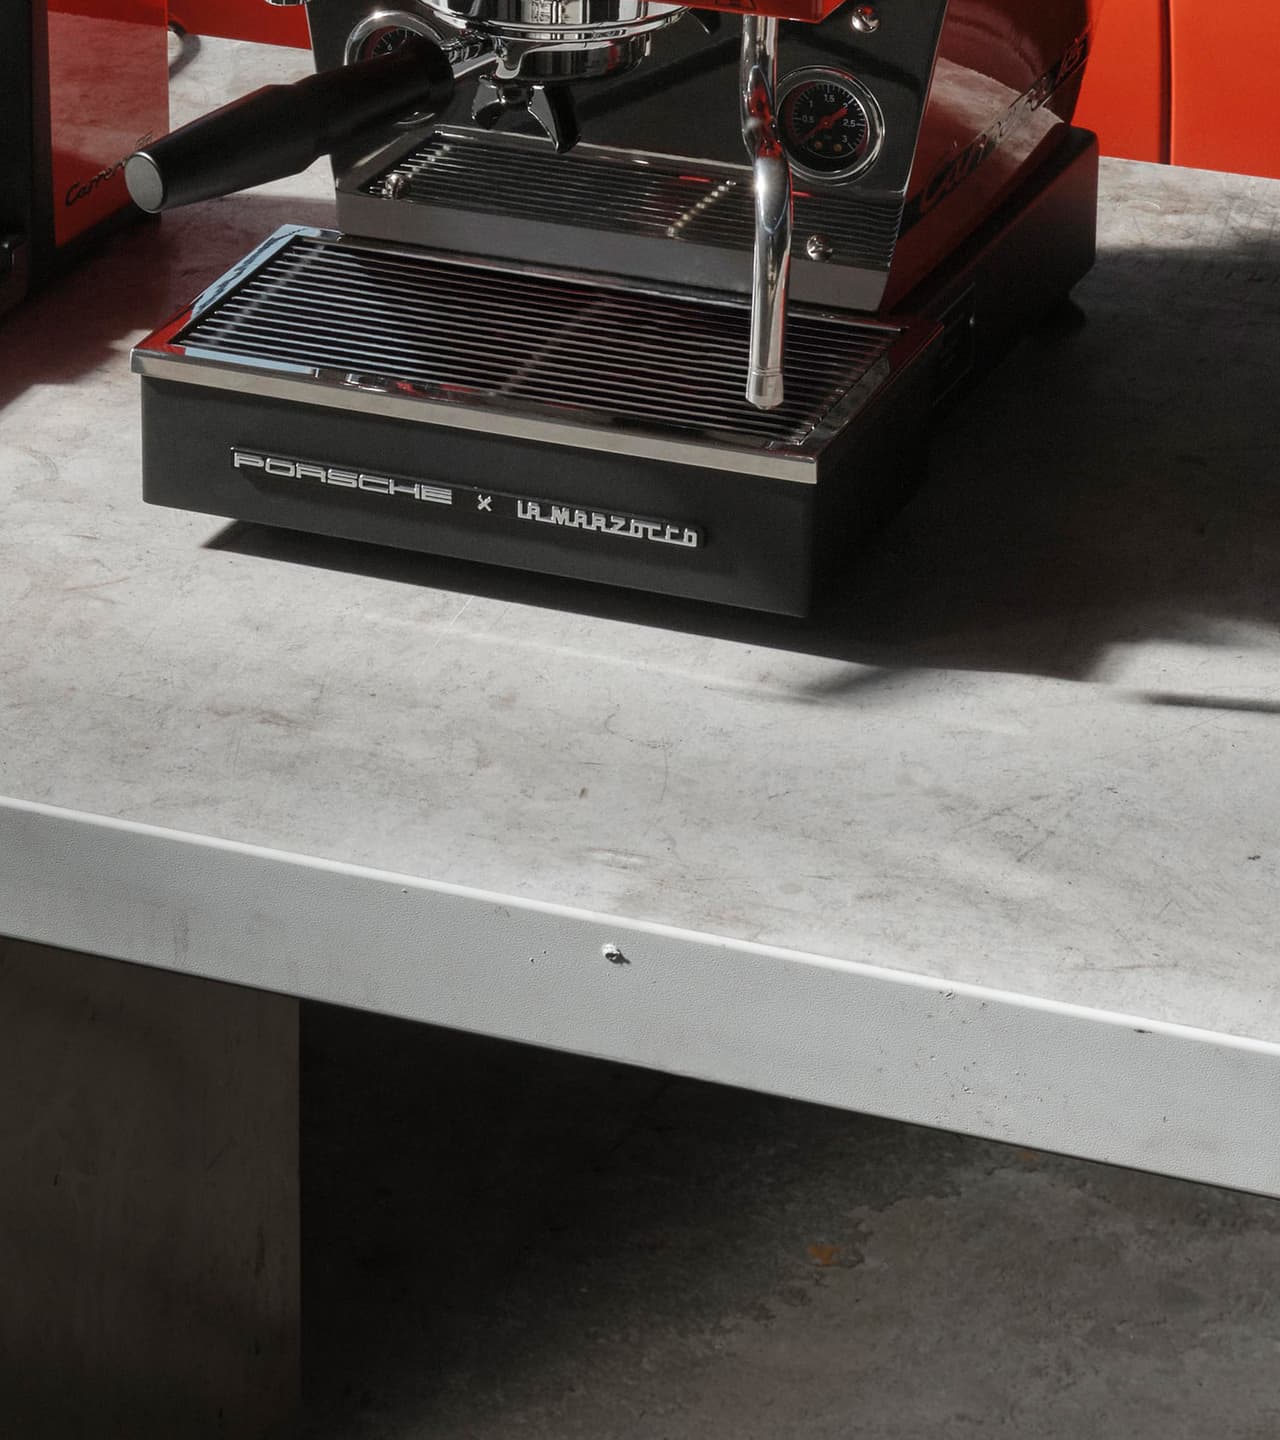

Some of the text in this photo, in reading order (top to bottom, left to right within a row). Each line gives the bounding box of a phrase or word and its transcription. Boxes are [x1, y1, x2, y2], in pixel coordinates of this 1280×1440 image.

[842, 118, 856, 127] 2.5
[65, 157, 127, 208] Carrer
[233, 451, 453, 505] PORSCHE
[517, 499, 540, 522] LA
[551, 504, 698, 548] MARZOCCO
